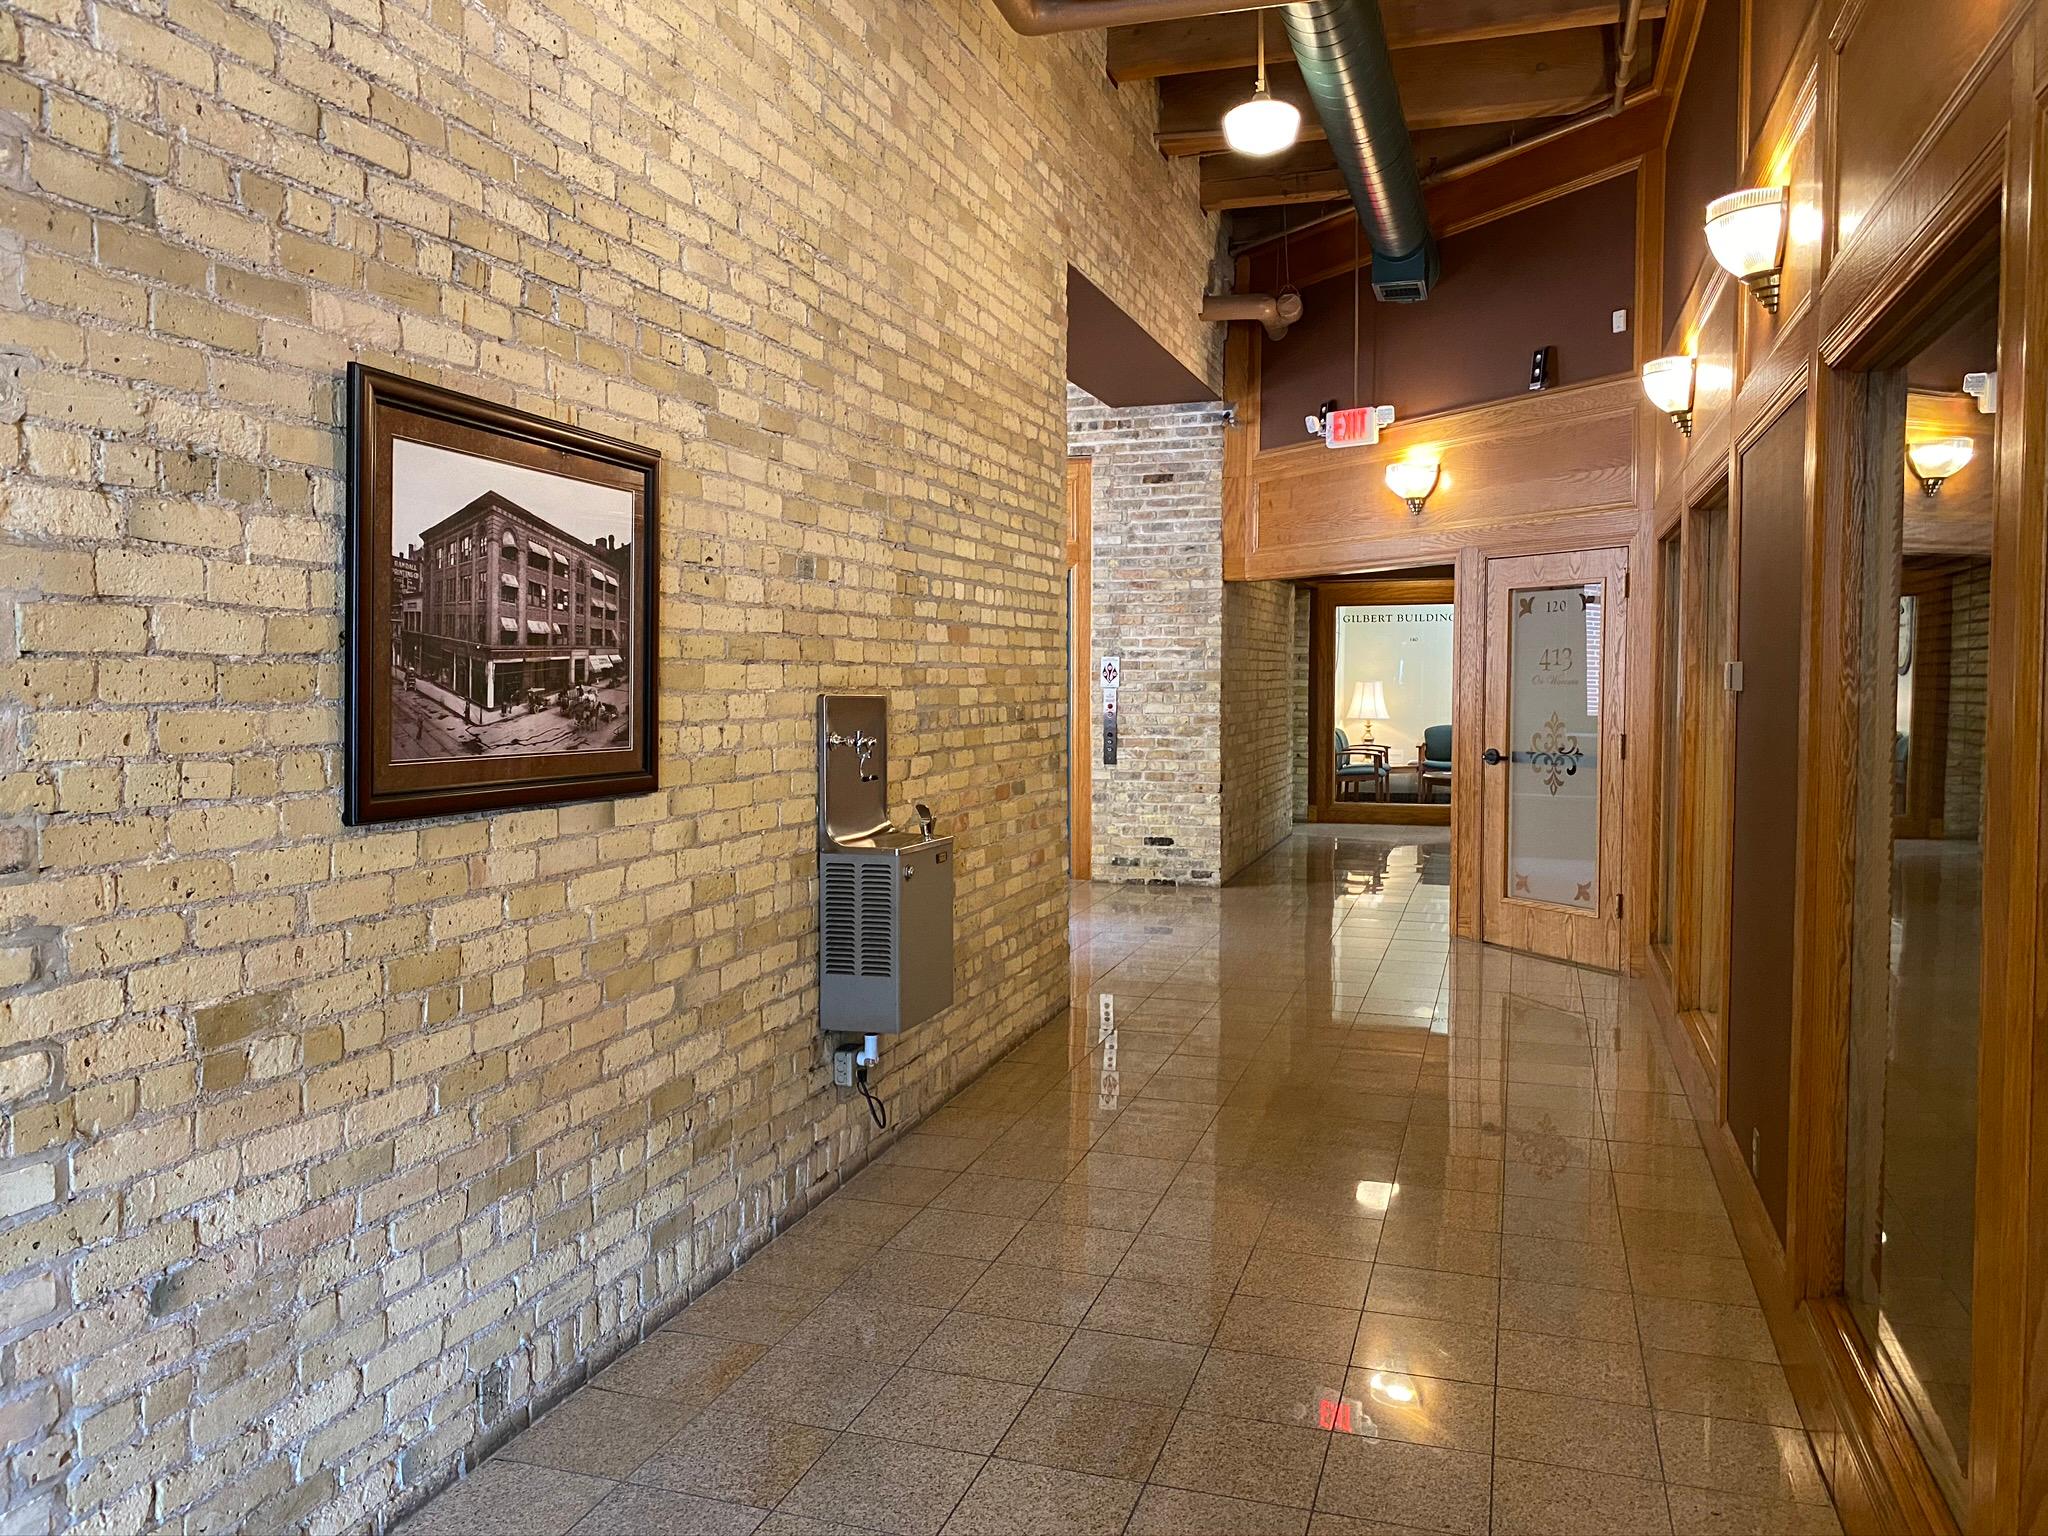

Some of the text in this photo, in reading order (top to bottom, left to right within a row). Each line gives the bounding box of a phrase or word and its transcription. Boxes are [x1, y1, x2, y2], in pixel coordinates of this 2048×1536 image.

[1334, 408, 1367, 441] EXIT
[1547, 600, 1567, 612] 120
[1343, 614, 1393, 623] GILBERT
[1539, 647, 1573, 671] 413
